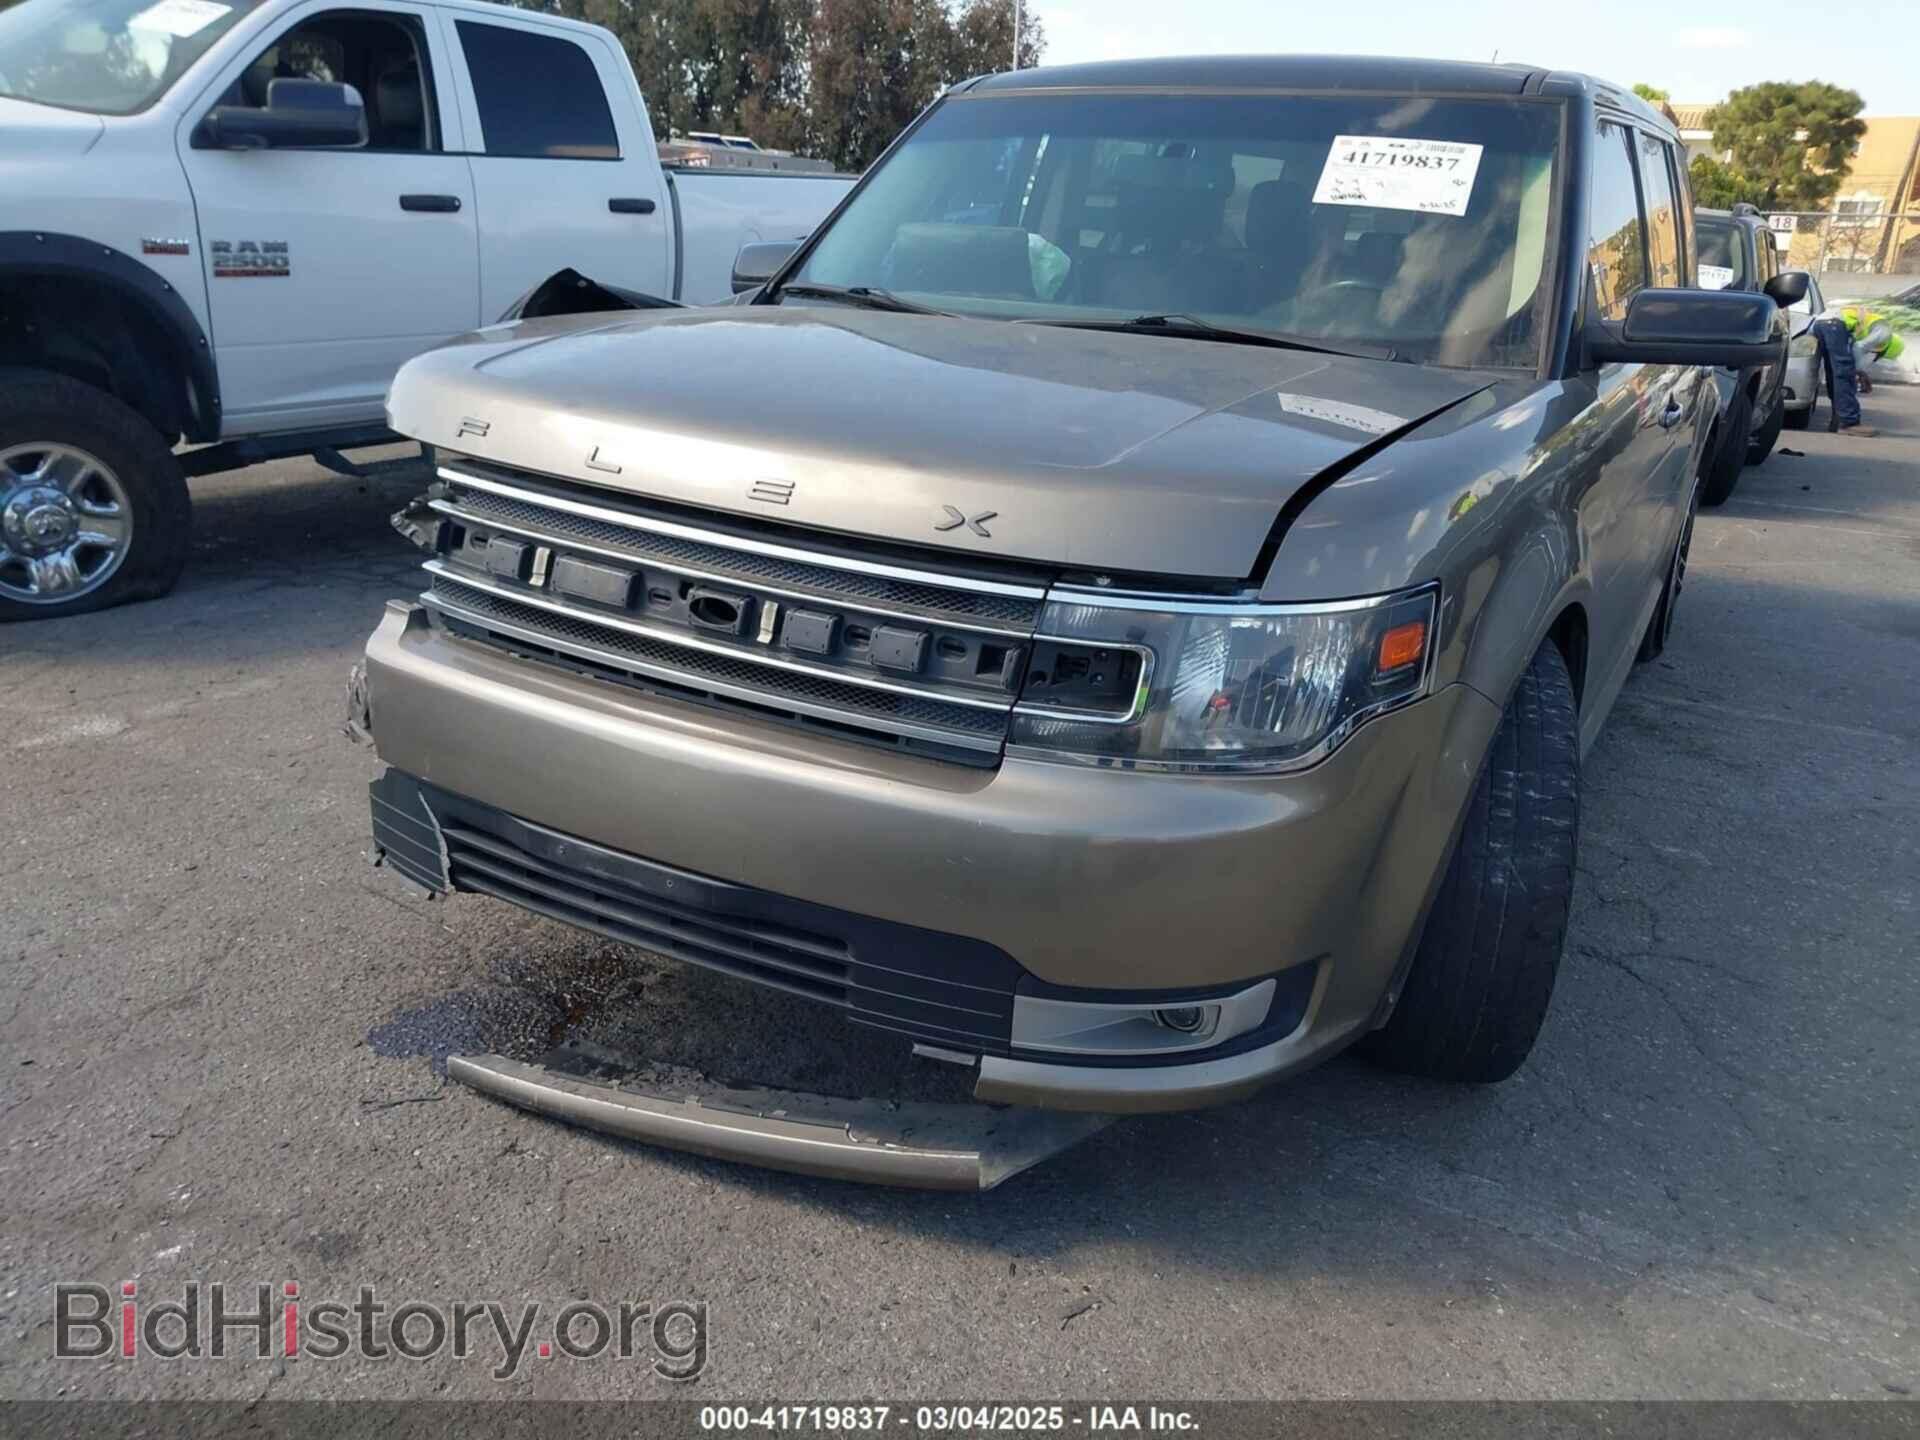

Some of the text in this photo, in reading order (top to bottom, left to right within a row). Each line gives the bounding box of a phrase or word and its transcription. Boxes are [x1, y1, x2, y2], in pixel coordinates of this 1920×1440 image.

[1342, 150, 1461, 172] 41719837
[1772, 216, 1793, 230] 18
[212, 240, 289, 254] RAM
[214, 254, 290, 269] 2500
[456, 416, 1000, 538] FLEX
